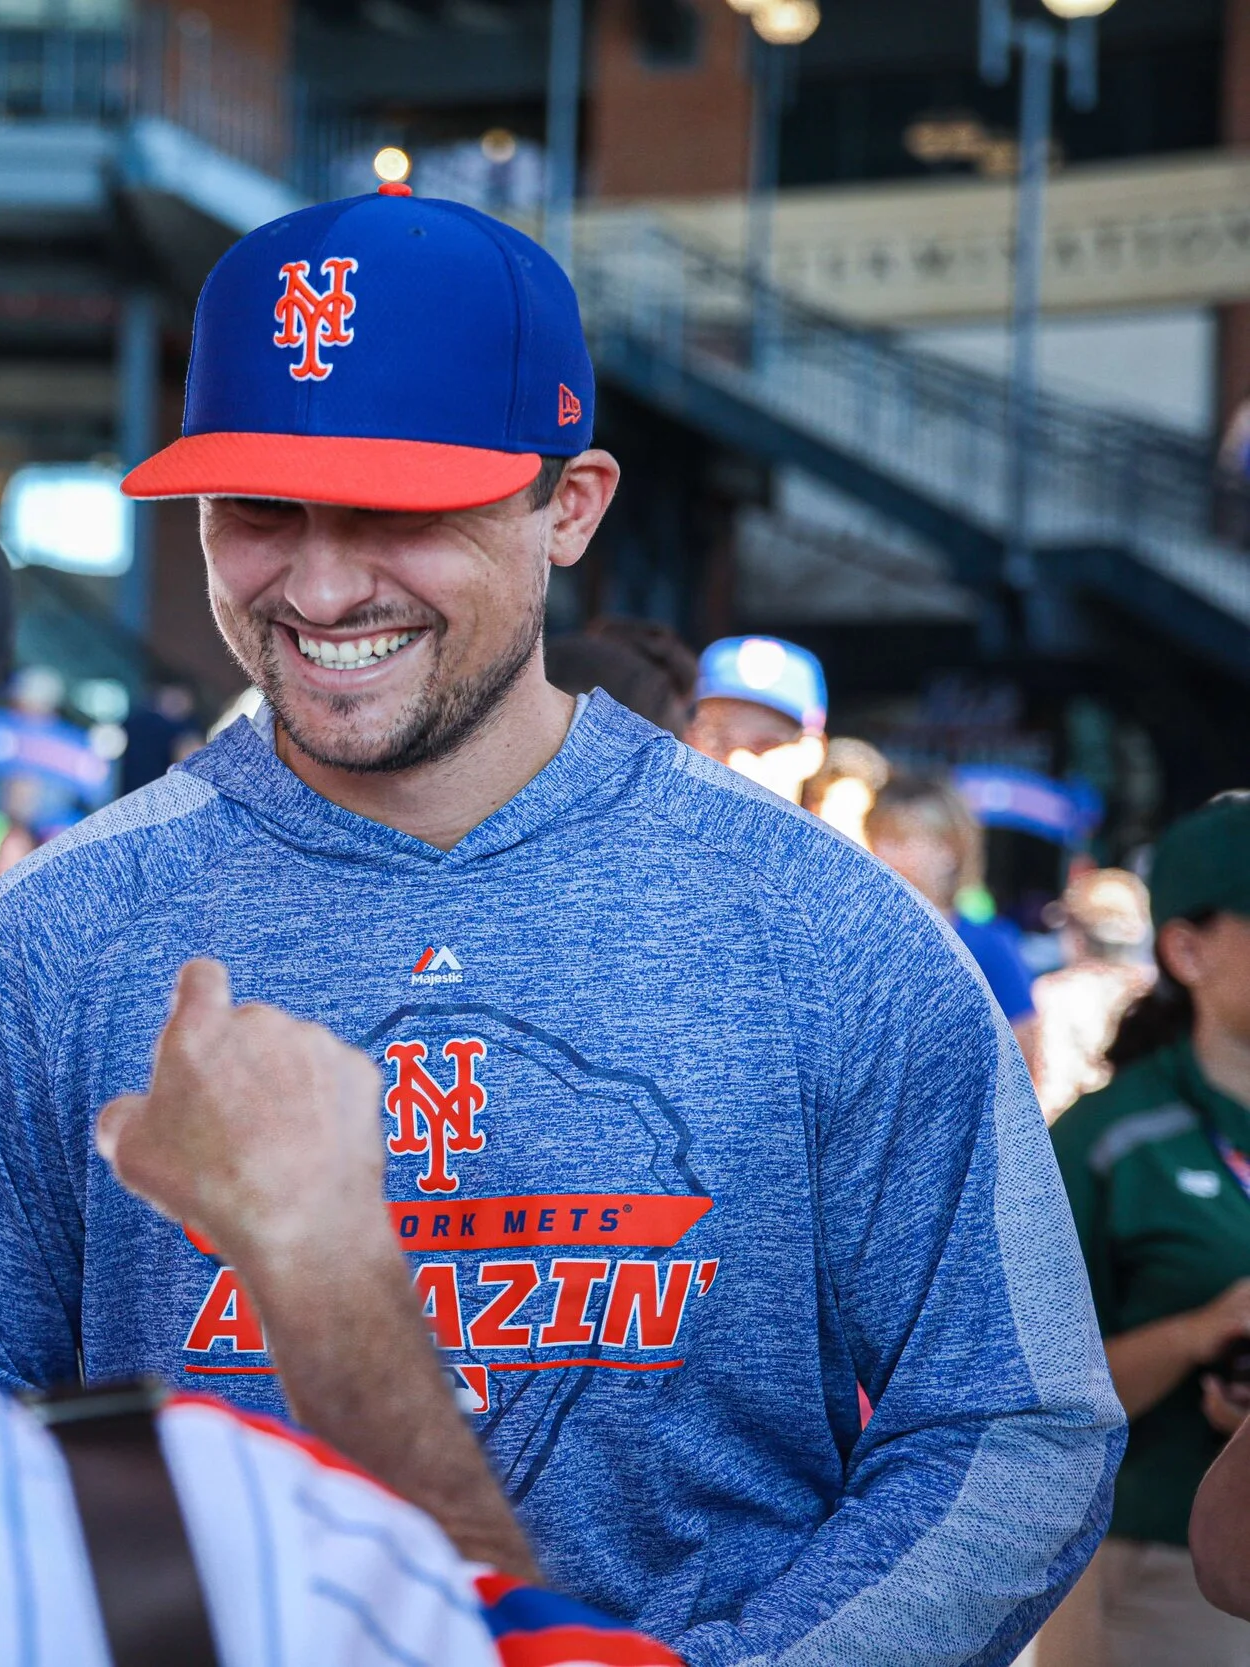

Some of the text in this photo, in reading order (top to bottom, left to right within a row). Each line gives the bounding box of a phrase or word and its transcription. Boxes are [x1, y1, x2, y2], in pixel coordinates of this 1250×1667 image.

[411, 973, 463, 986] Majestic
[400, 1214, 476, 1238] ORK
[183, 1258, 720, 1351] AAZIN'
